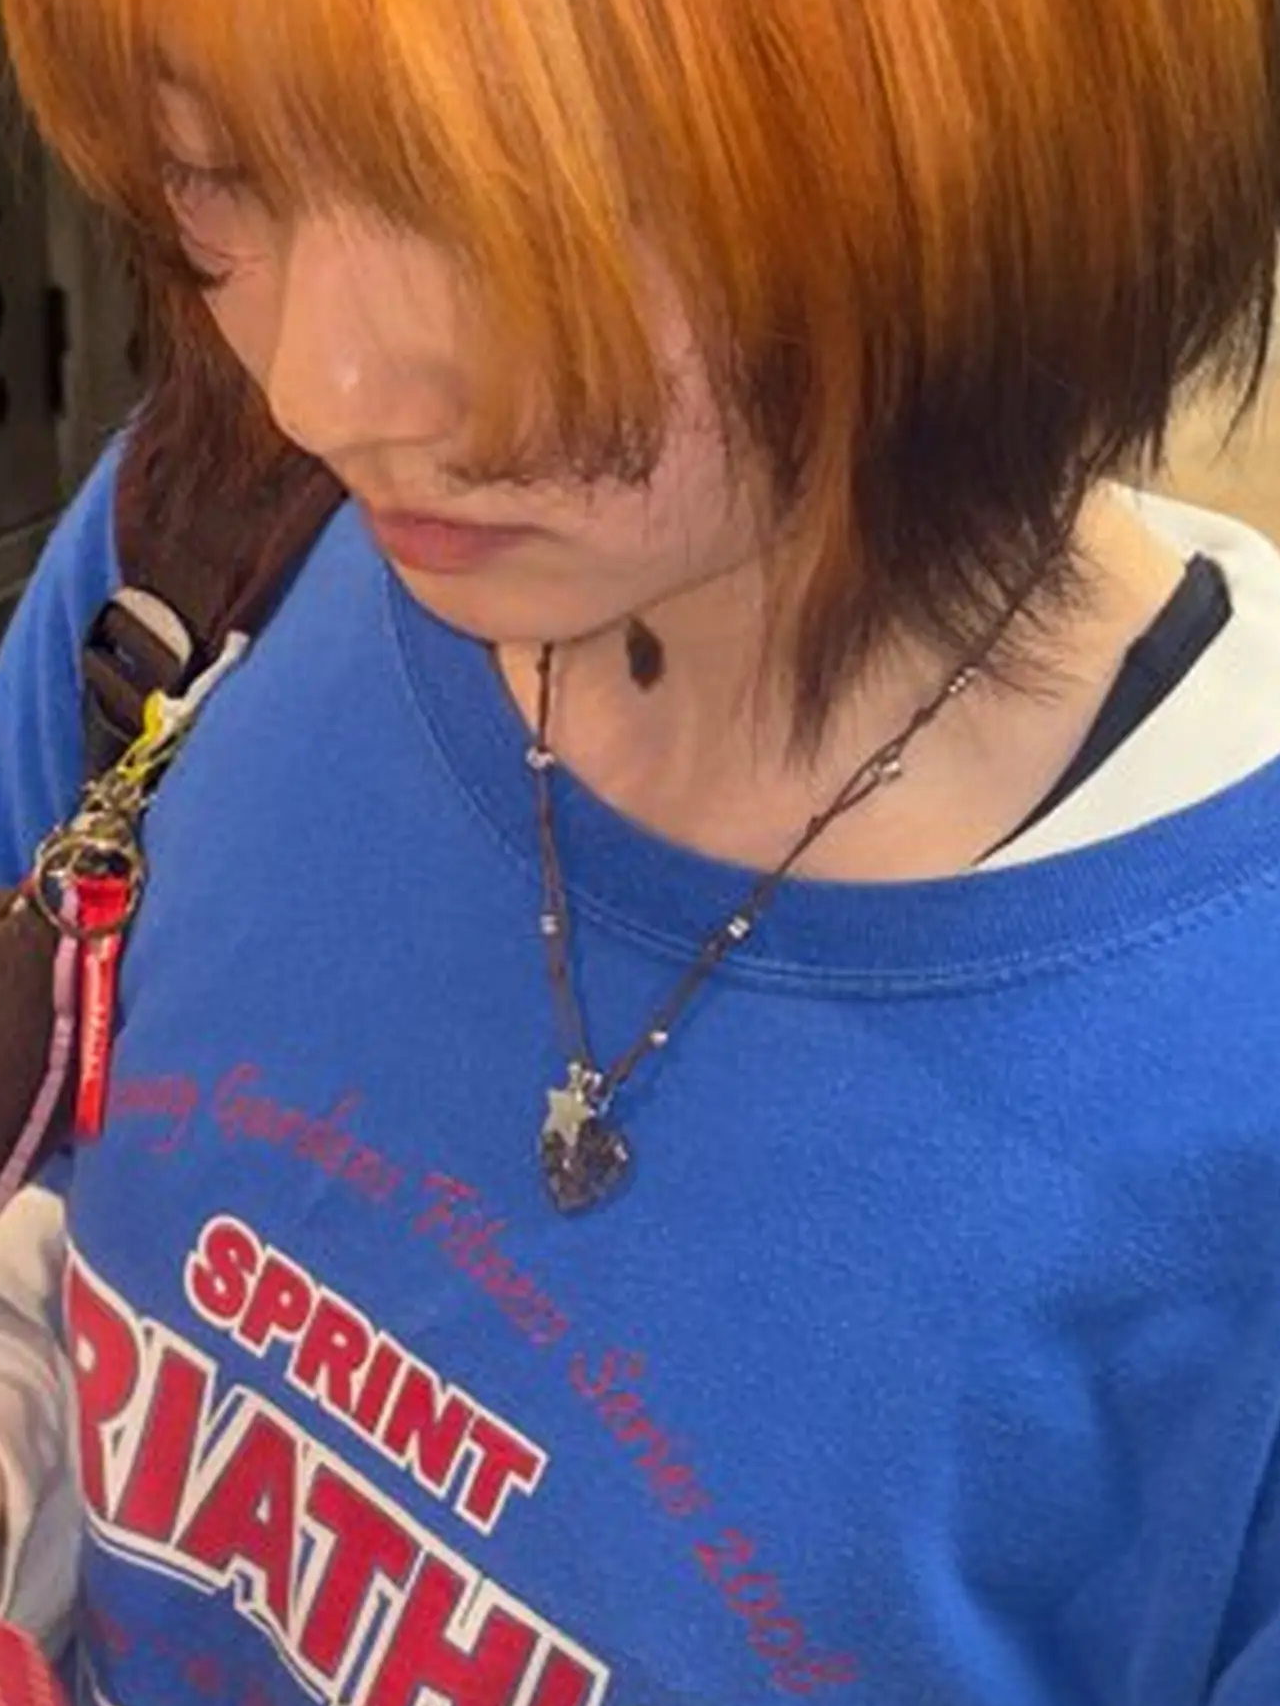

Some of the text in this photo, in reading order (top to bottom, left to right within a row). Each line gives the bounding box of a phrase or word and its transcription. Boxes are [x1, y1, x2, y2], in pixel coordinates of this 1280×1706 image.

[185, 1215, 548, 1536] SPRINT
[568, 1346, 712, 1517] Series
[694, 1528, 860, 1695] 2008
